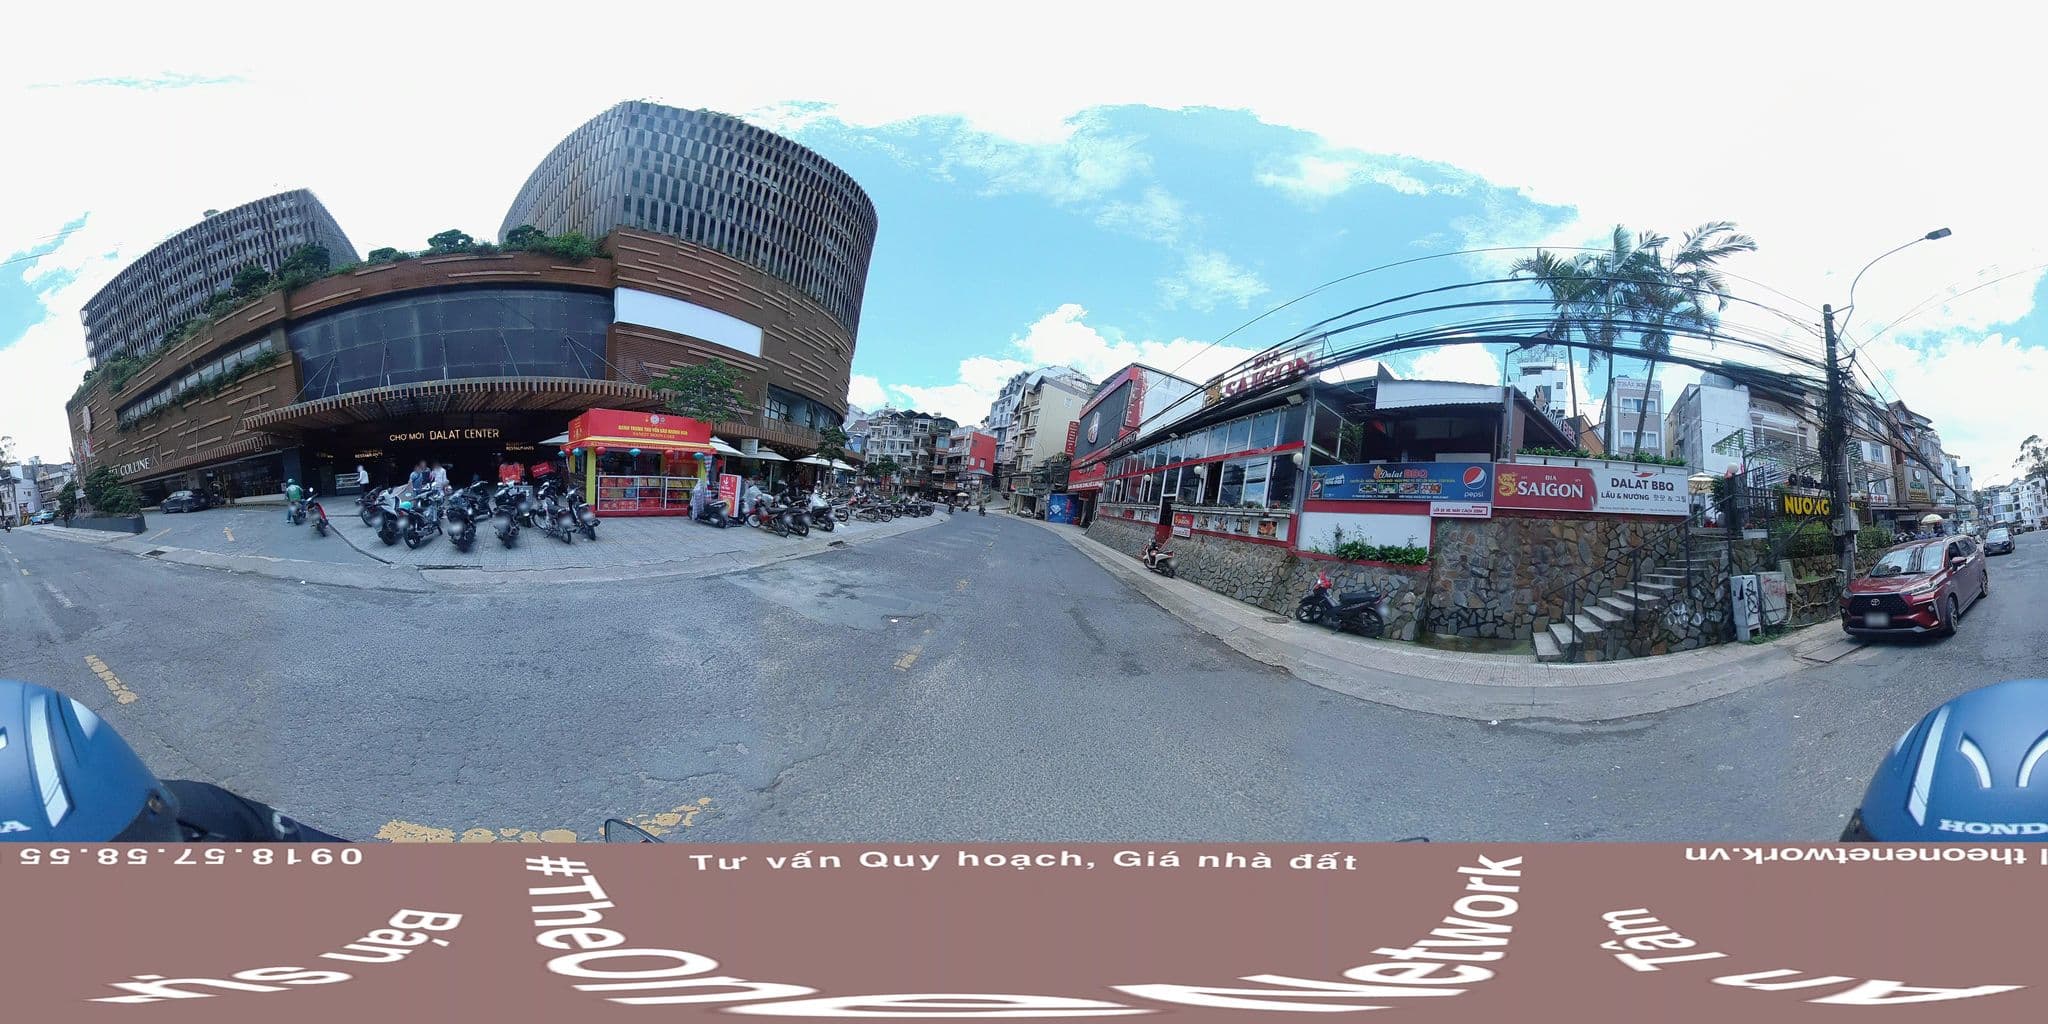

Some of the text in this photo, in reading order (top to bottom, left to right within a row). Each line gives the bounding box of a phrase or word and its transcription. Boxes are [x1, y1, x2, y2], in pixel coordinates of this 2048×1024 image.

[429, 430, 460, 440] DALAT
[464, 428, 500, 439] CENTER
[1403, 469, 1428, 478] BBQ
[1517, 481, 1584, 499] SAIGON
[1611, 477, 1675, 492] DALAT BBQ
